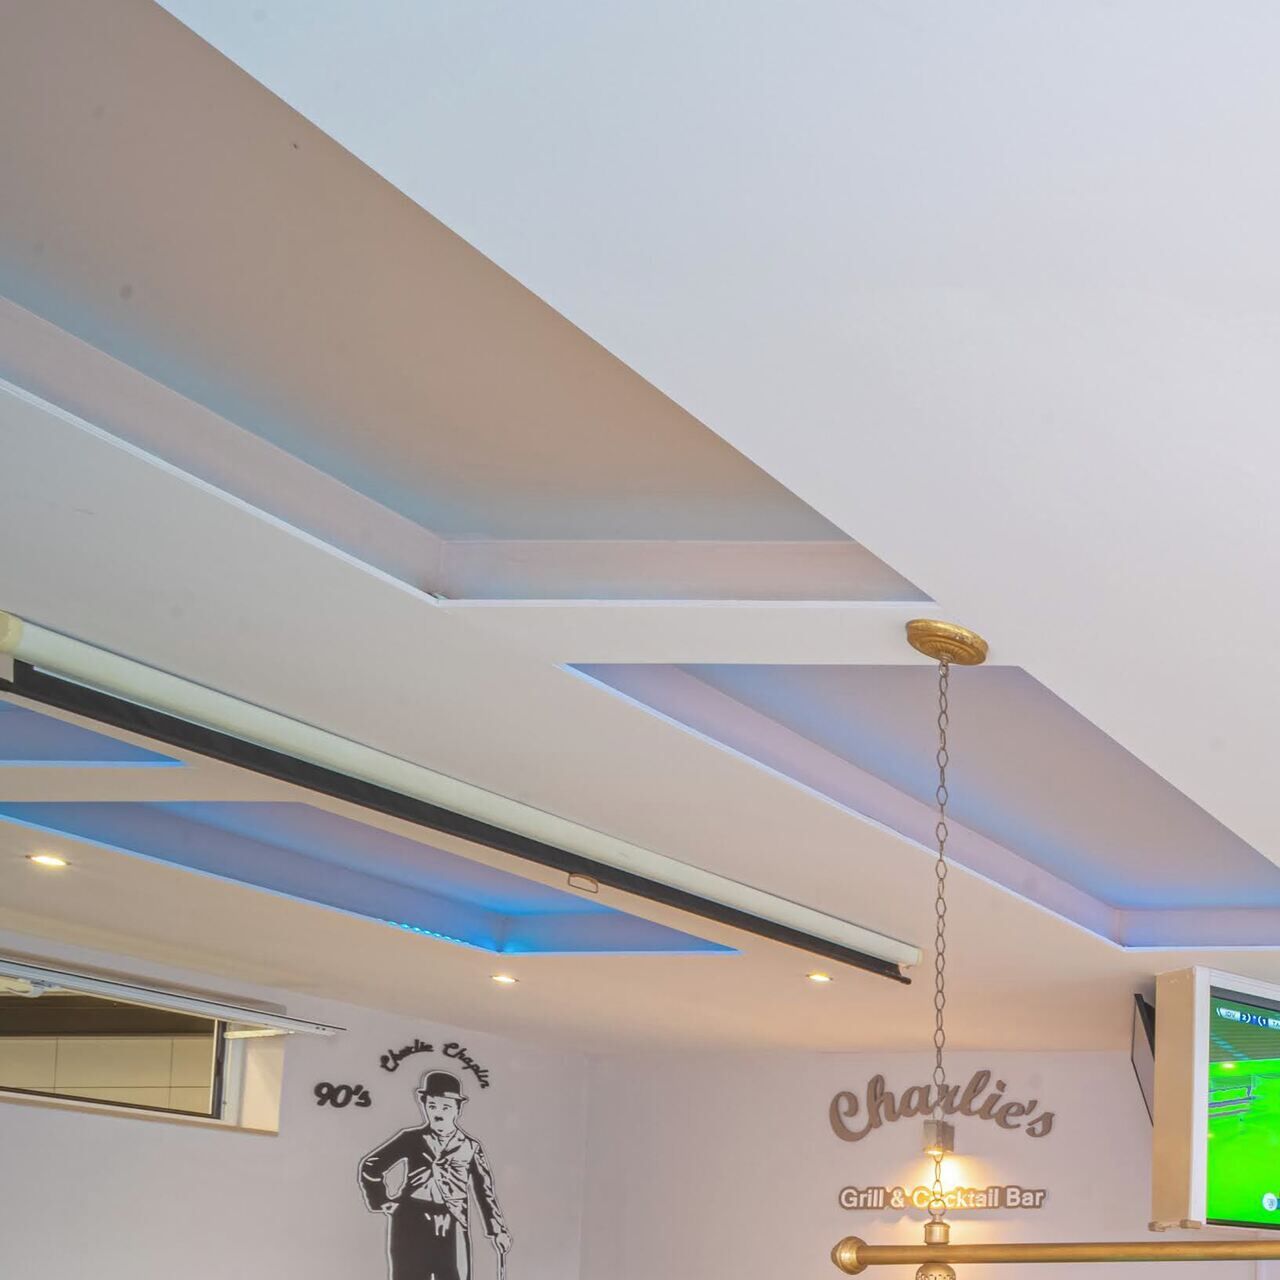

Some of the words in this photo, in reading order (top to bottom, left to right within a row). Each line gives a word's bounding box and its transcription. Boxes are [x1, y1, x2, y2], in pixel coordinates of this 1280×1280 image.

[380, 1039, 434, 1072] Charlie
[442, 1042, 490, 1089] Chaplin
[314, 1082, 372, 1108] 90's
[829, 1070, 1055, 1142] Charlie's
[840, 1187, 884, 1208] Grill
[890, 1187, 906, 1208] &
[912, 1187, 999, 1208] Cocktail
[1005, 1187, 1045, 1208] Bar
